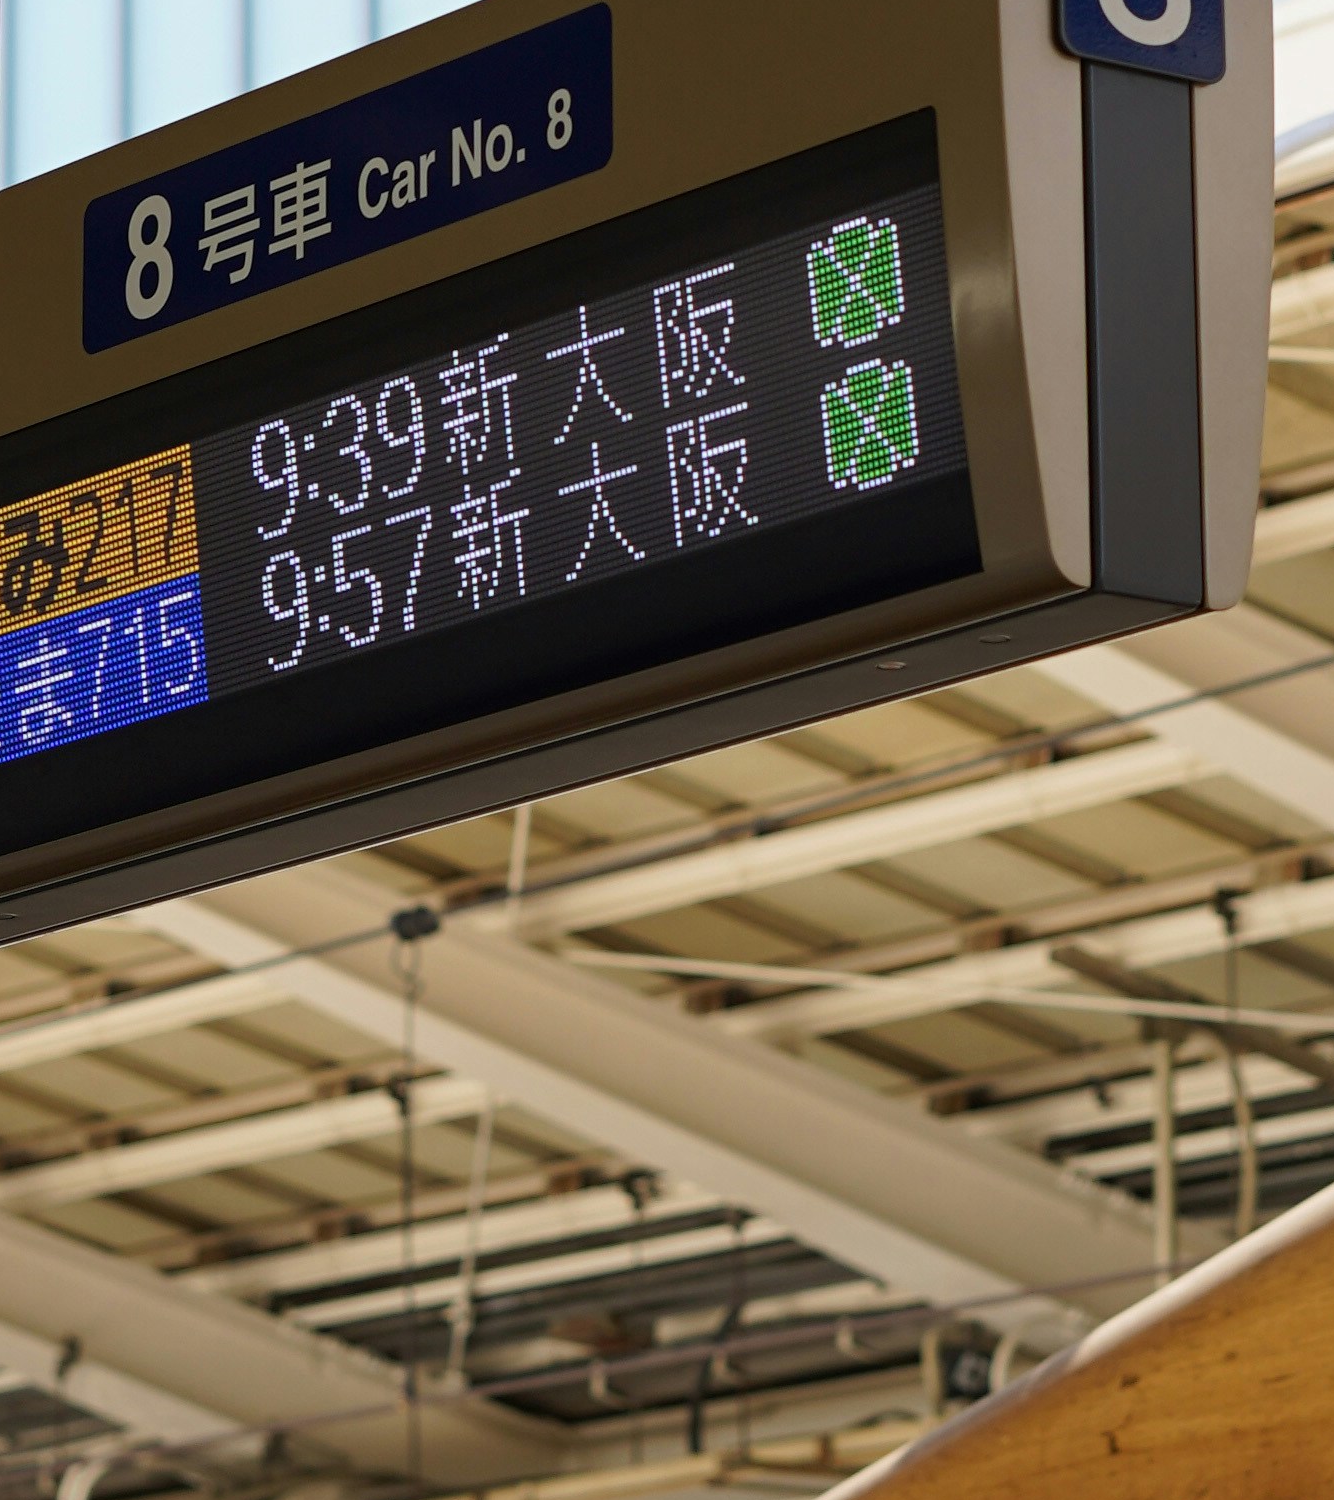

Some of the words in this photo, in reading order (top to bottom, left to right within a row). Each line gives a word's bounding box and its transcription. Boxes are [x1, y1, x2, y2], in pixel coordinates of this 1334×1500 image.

[357, 148, 436, 219] Car
[451, 118, 526, 187] No.
[547, 88, 573, 150] 8
[251, 375, 426, 540] 9:39
[439, 263, 746, 476] 新大阪
[262, 505, 431, 671] 9:57
[450, 401, 758, 609] 新大阪
